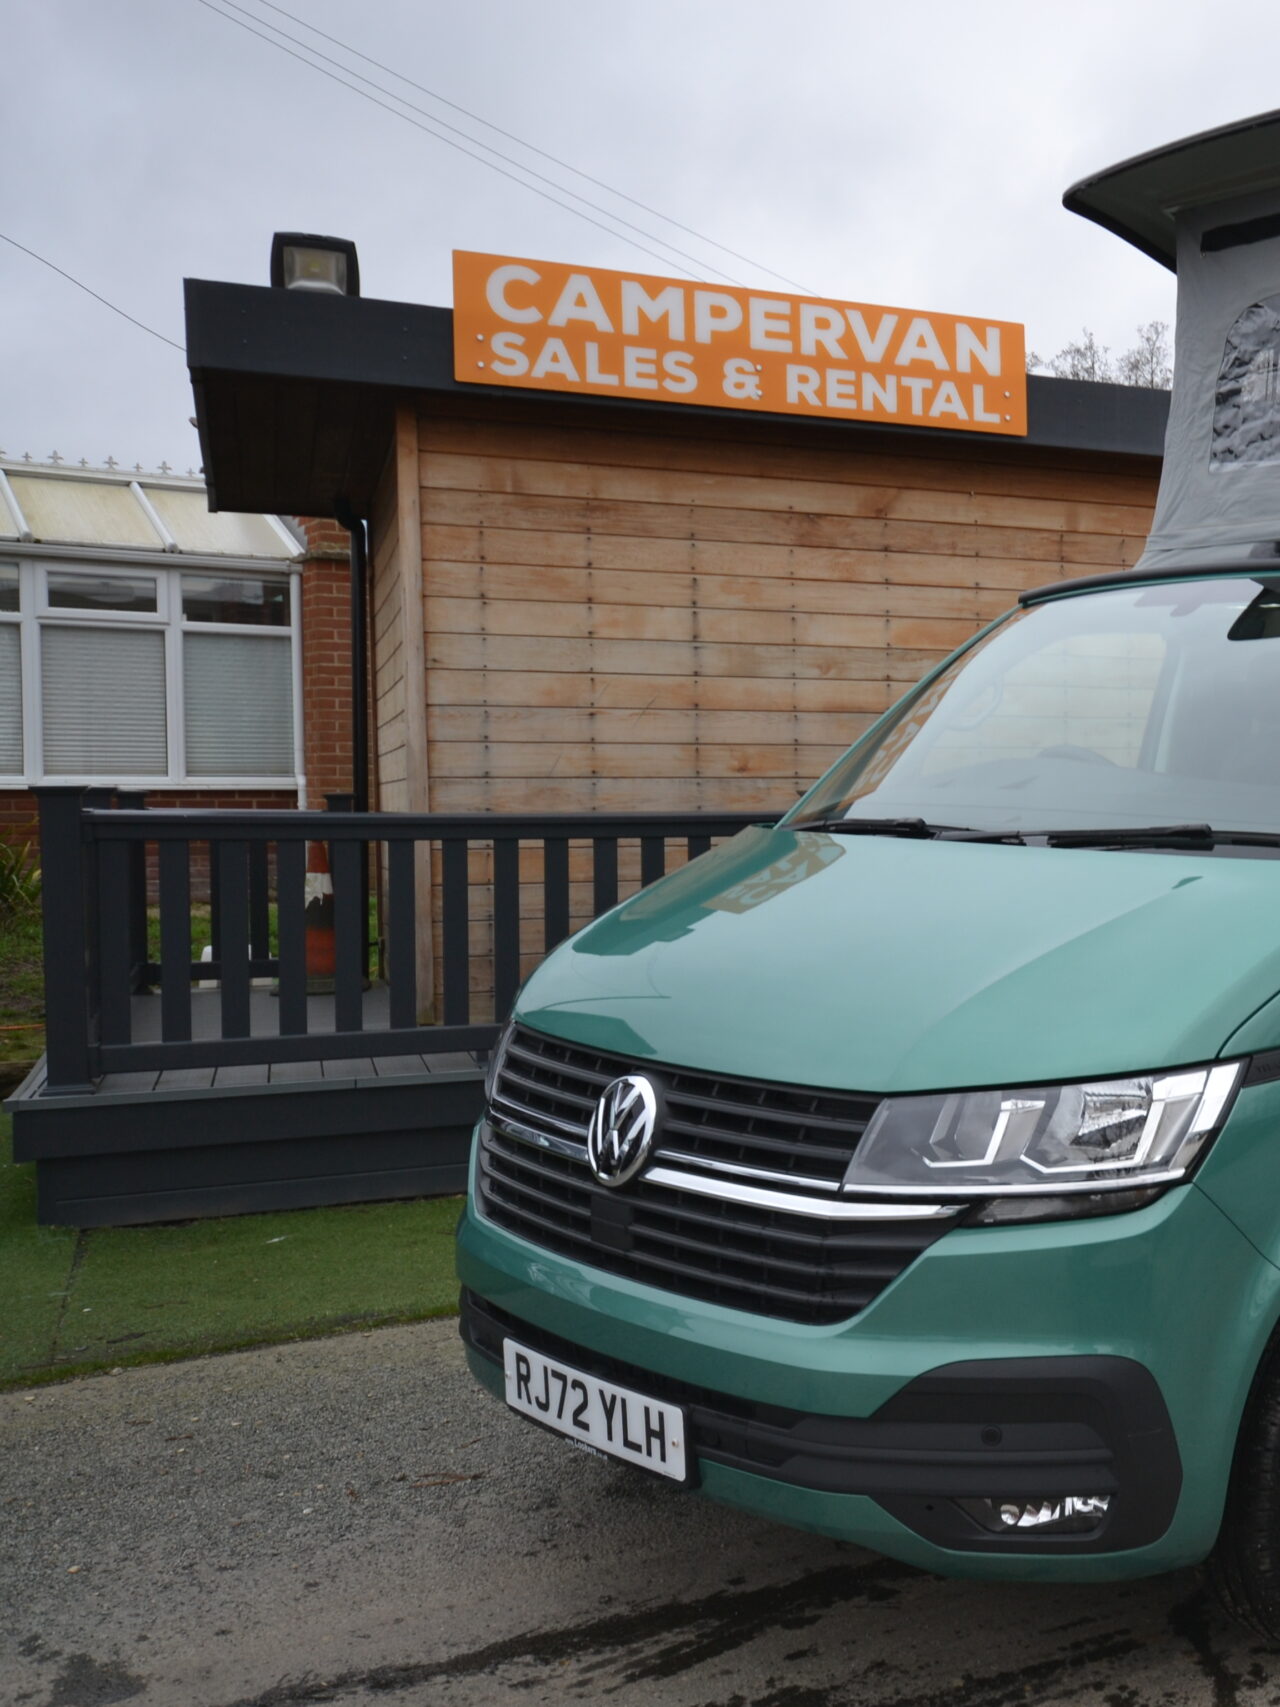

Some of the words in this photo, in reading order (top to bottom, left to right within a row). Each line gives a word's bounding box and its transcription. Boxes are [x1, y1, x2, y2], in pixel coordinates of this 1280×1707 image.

[485, 264, 1001, 376] CAMPERVAN
[490, 331, 698, 393] SALES
[721, 357, 762, 400] &
[785, 364, 1001, 423] RENTAL
[515, 1351, 590, 1433] RJ72
[599, 1388, 667, 1463] YLH
